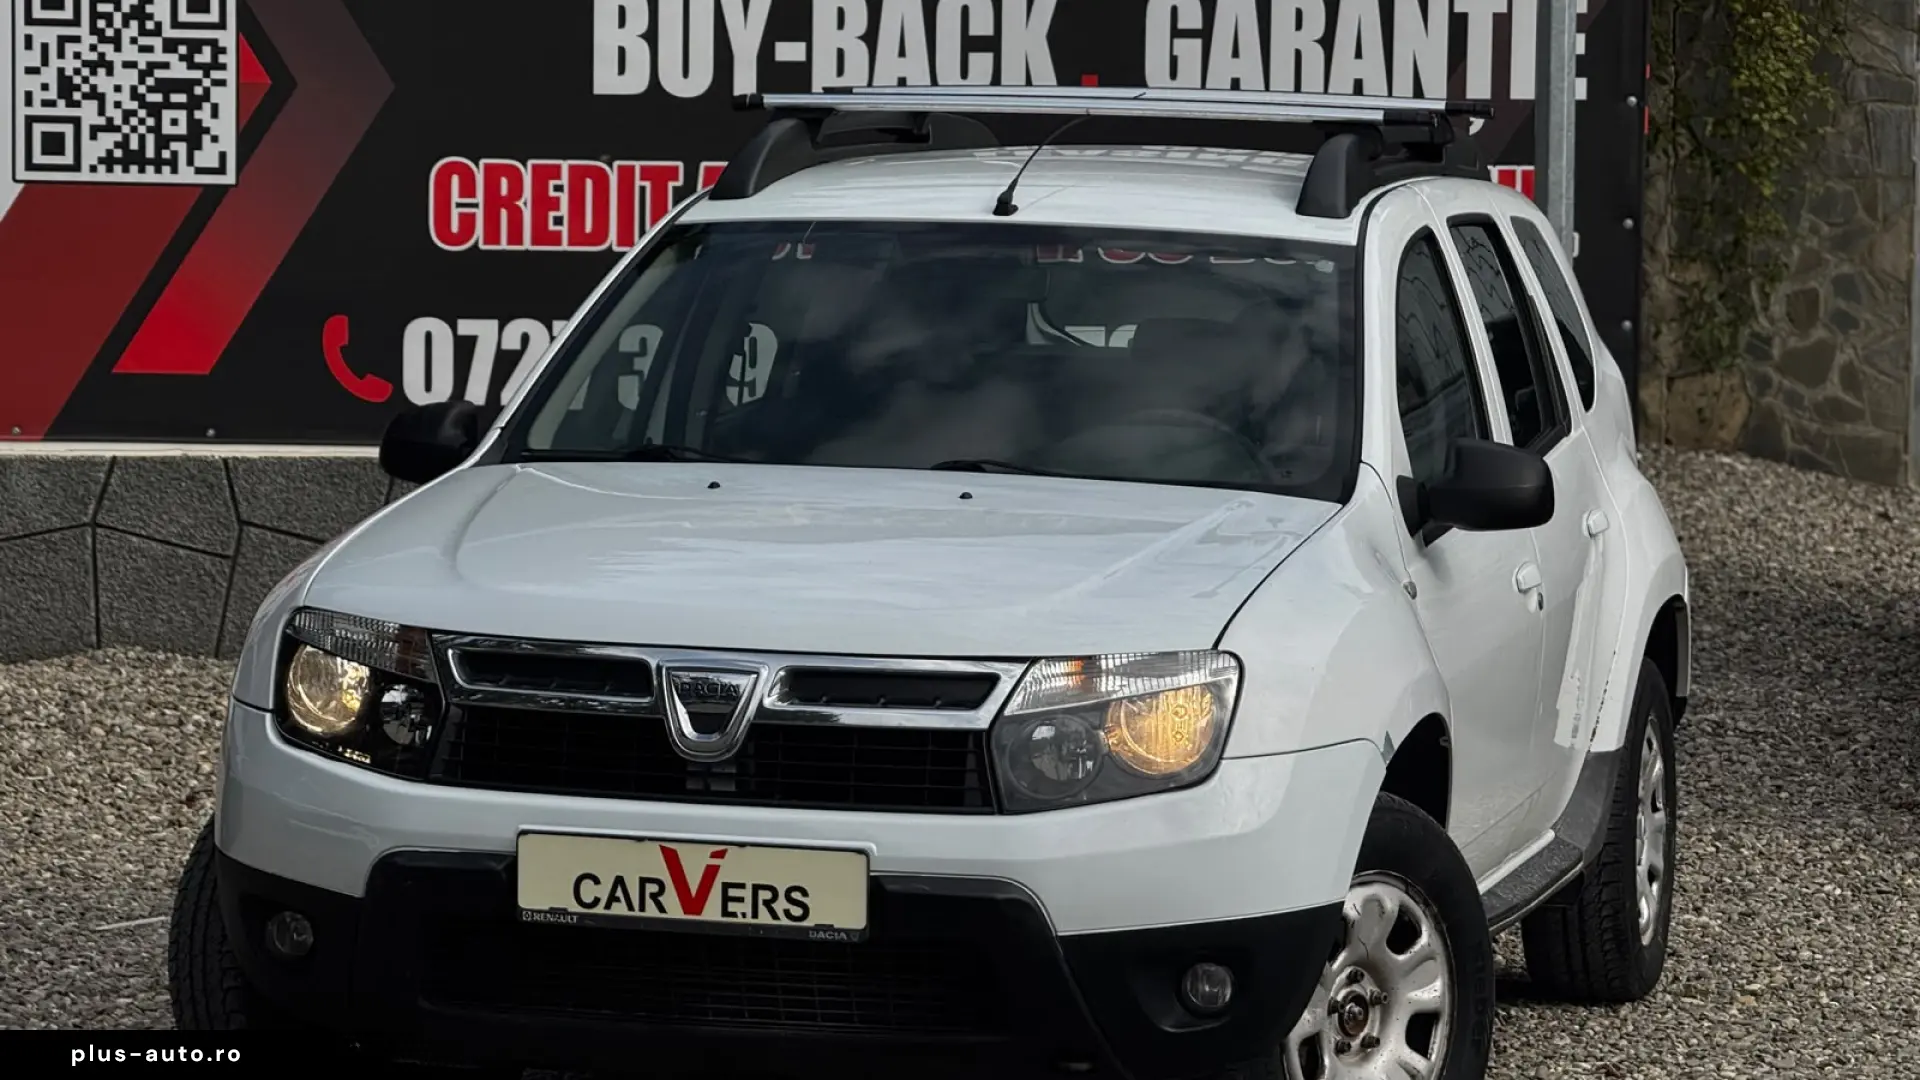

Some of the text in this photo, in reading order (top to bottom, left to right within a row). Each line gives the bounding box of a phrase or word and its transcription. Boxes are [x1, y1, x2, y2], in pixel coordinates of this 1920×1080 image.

[592, 0, 1057, 98] BUY-BACK
[429, 156, 683, 252] CREDIT
[533, 913, 848, 941] RENAULT DACIA
